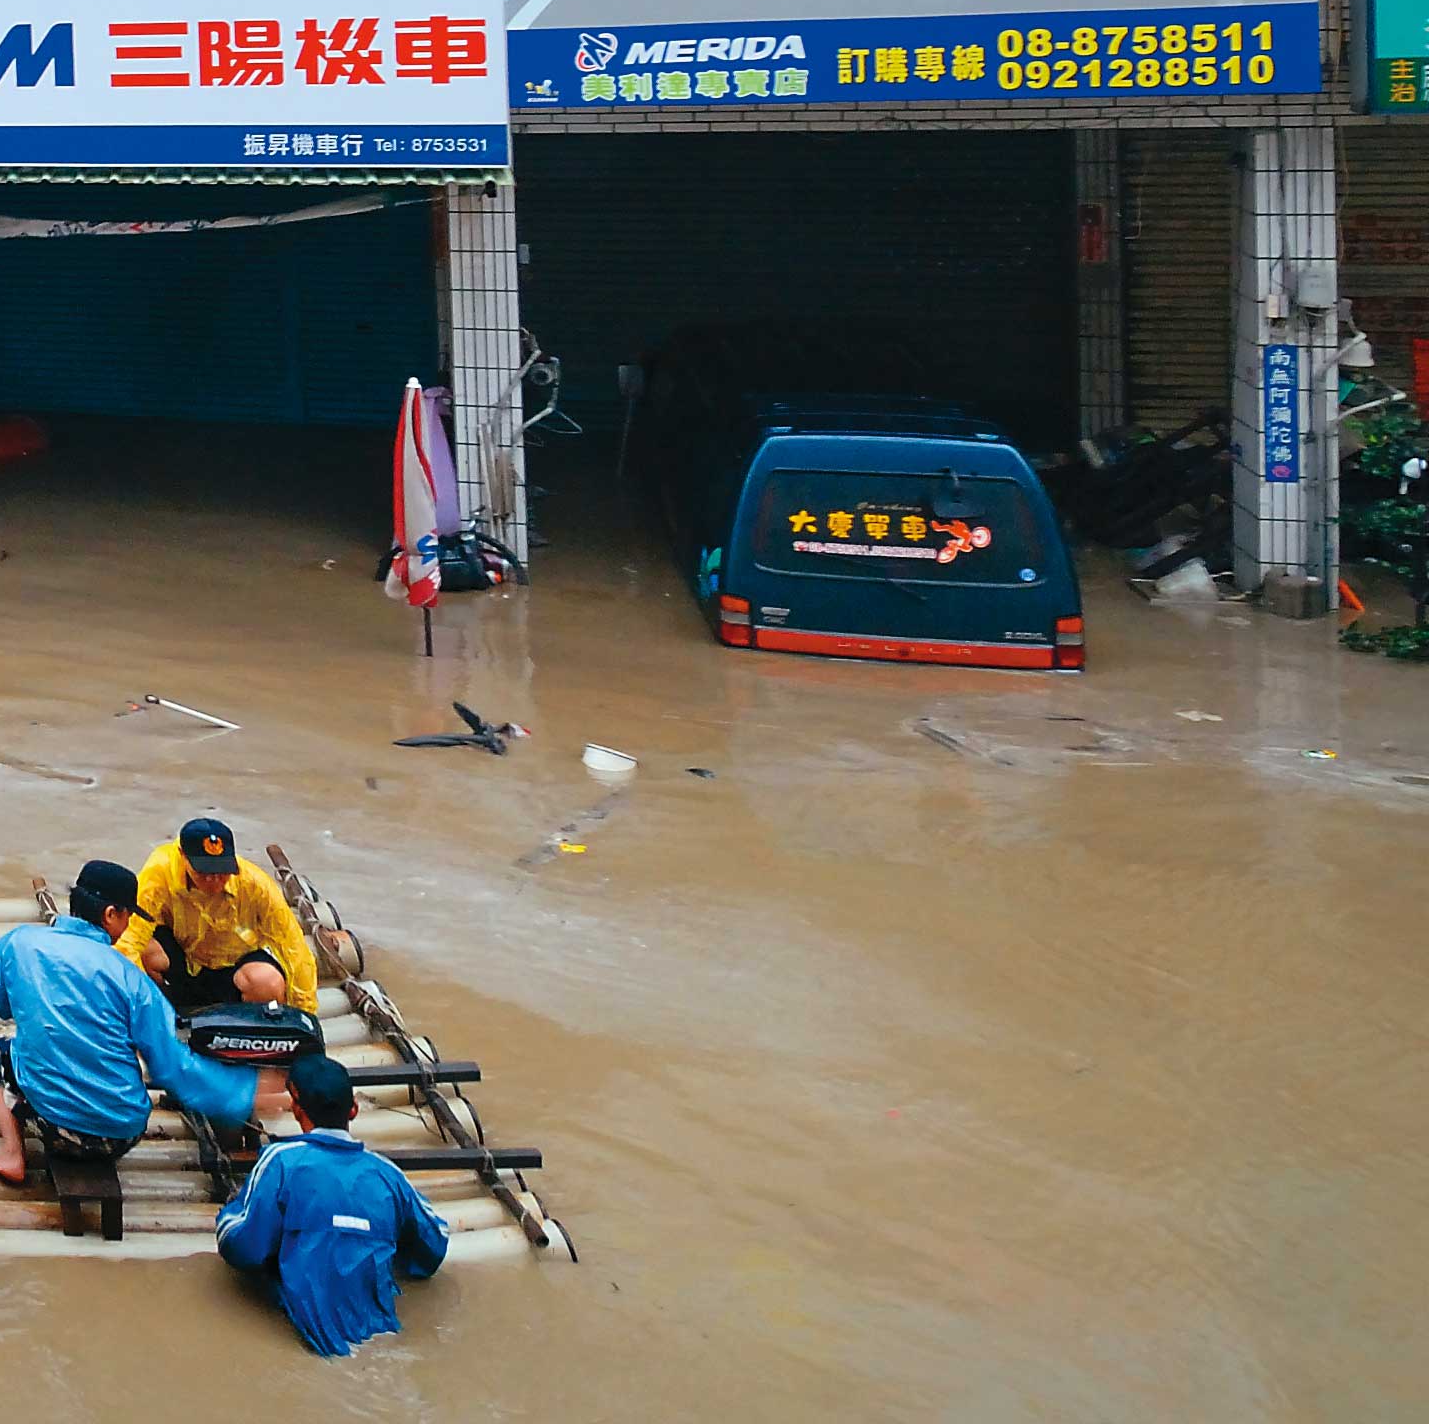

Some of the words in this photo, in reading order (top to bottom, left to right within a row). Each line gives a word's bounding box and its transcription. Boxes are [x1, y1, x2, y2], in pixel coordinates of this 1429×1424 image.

[108, 15, 488, 88] 三陽機車
[623, 35, 807, 66] MERIDA
[997, 21, 1273, 57] 08-8758511
[837, 44, 986, 85] 訂購專線
[997, 54, 1275, 91] 0921288510
[1389, 59, 1417, 103] 主治
[581, 67, 809, 102] 美利達專賣店
[243, 134, 364, 157] 振昇機車行
[373, 137, 405, 152] Tel:
[411, 138, 488, 153] 8753531
[1269, 348, 1292, 463] 南無阿彌陀佛
[788, 509, 928, 542] 大慶單車
[212, 1035, 300, 1053] MERCURY
